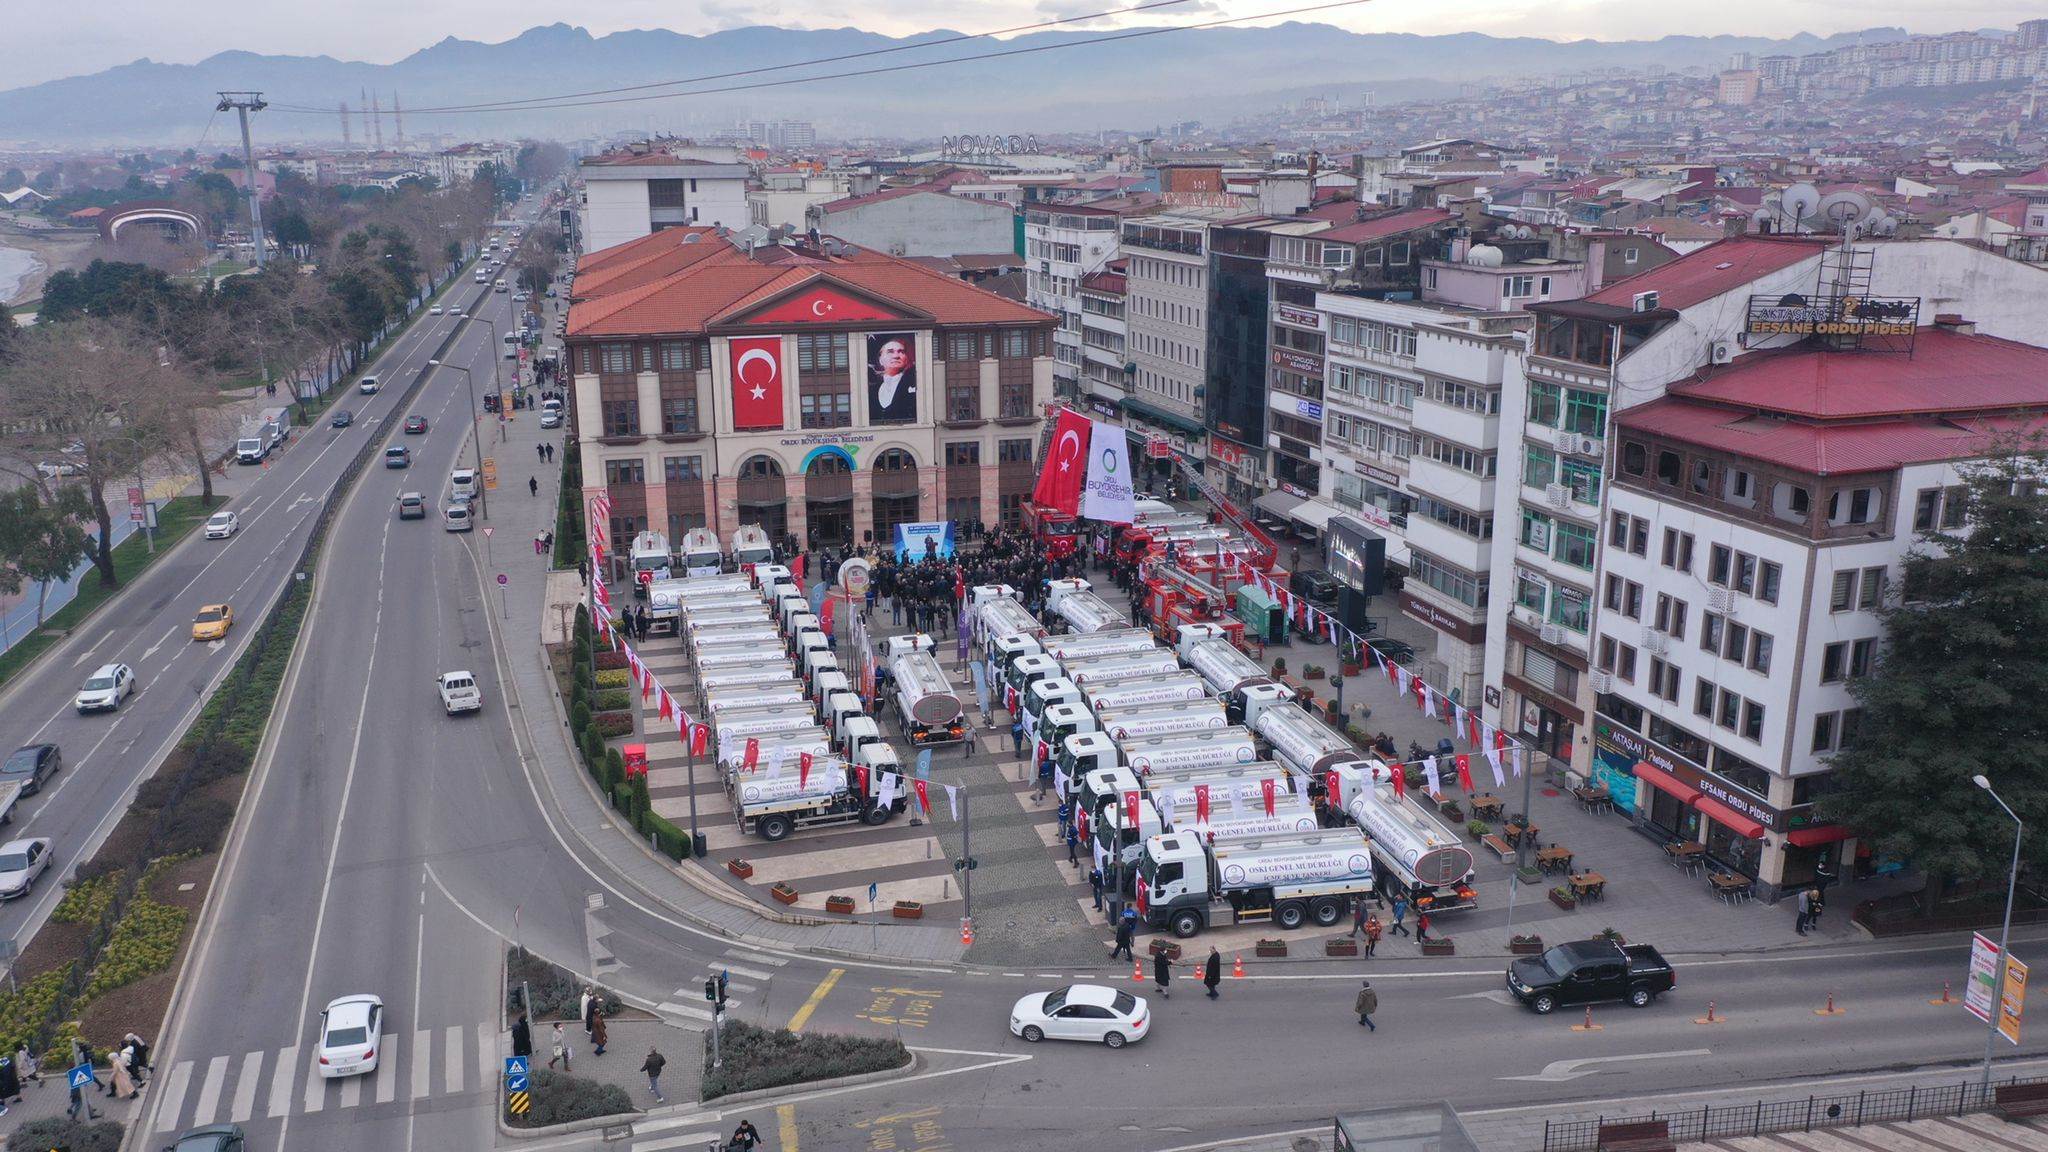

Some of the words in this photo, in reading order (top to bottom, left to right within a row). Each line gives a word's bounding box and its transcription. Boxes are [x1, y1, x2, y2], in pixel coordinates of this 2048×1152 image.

[941, 134, 1039, 155] NOVADA
[1758, 308, 1827, 322] AKTAŞLAR
[1752, 322, 1813, 334] EFSANE
[1816, 322, 1861, 334] ORDU
[1864, 322, 1914, 336] PİDESİ
[1104, 476, 1117, 484] ORDU
[1088, 480, 1132, 495] BÜYÜKŞEHİR
[1410, 600, 1430, 616] TÜRKİYE
[1435, 614, 1456, 629] BANKASI
[1612, 732, 1642, 754] AKTAŞLAR
[1700, 780, 1727, 800] EFSANE
[1728, 794, 1748, 812] ORDU
[1749, 804, 1773, 826] PİDESİ
[1222, 828, 1246, 837] GENEL
[1246, 823, 1291, 834] MÜDÜRLÜĞÜ
[1248, 864, 1268, 874] OSKİ
[1268, 864, 1294, 872] GENEL
[1295, 860, 1344, 870] MÜDÜRLÜĞÜ
[1282, 872, 1301, 880] SUYU
